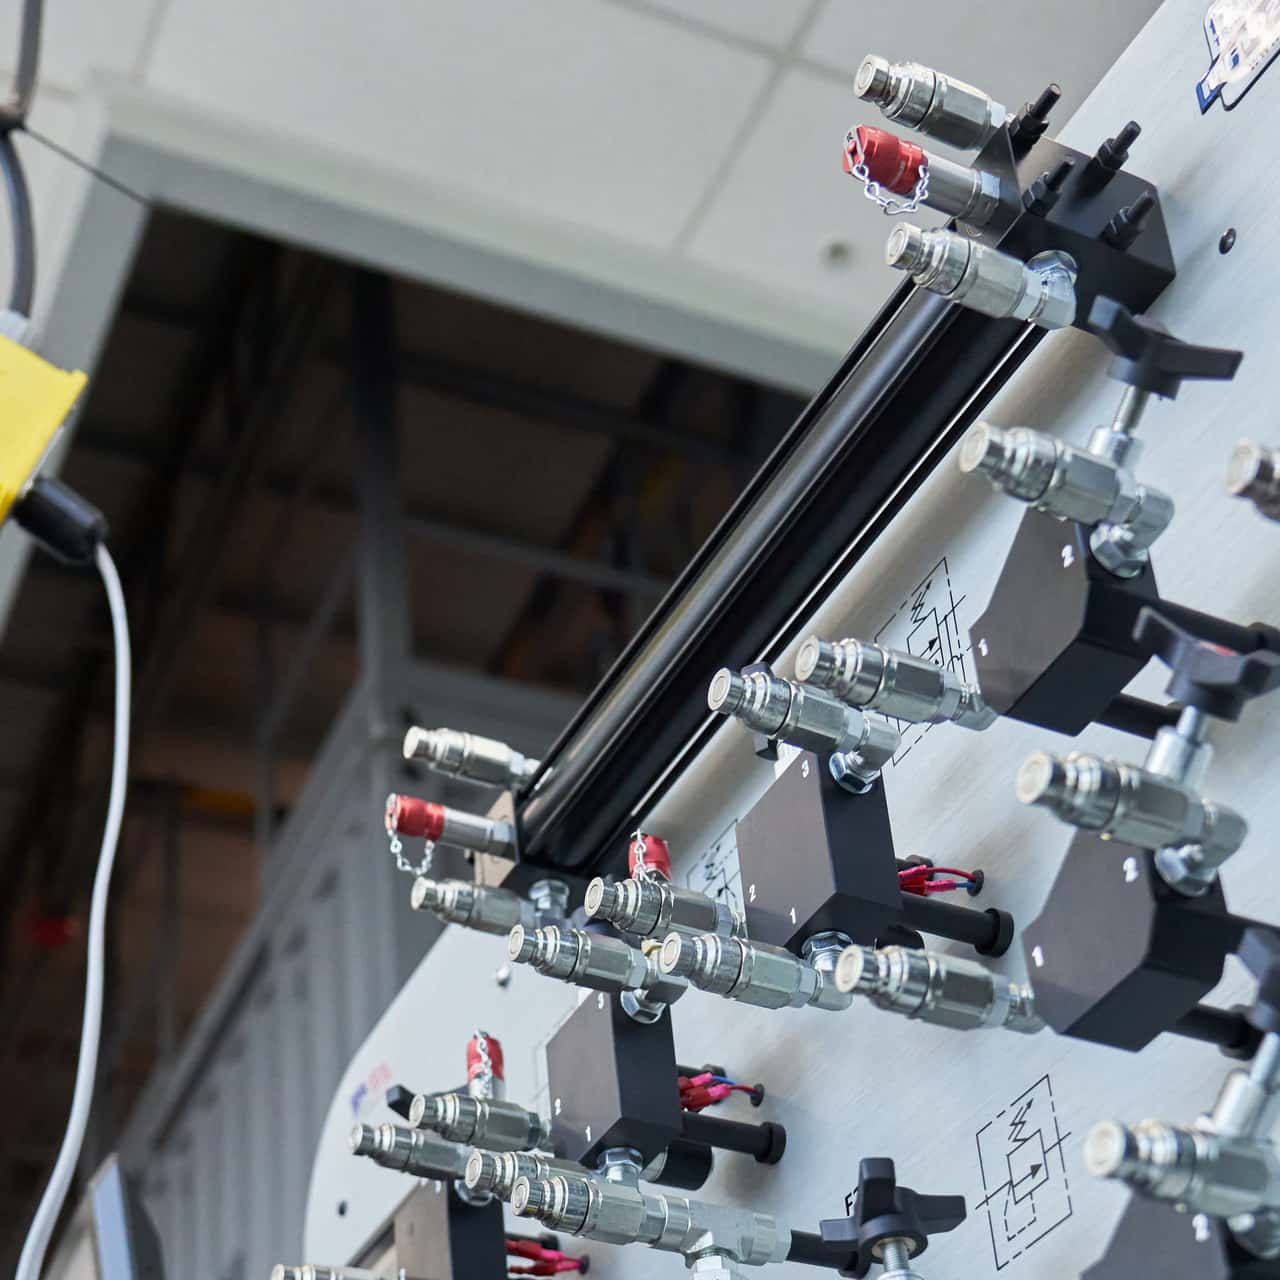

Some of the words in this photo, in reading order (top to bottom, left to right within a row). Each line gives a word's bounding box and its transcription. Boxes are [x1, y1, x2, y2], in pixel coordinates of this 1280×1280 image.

[748, 884, 756, 902] 2
[789, 907, 796, 924] 1
[1031, 946, 1044, 967] 1
